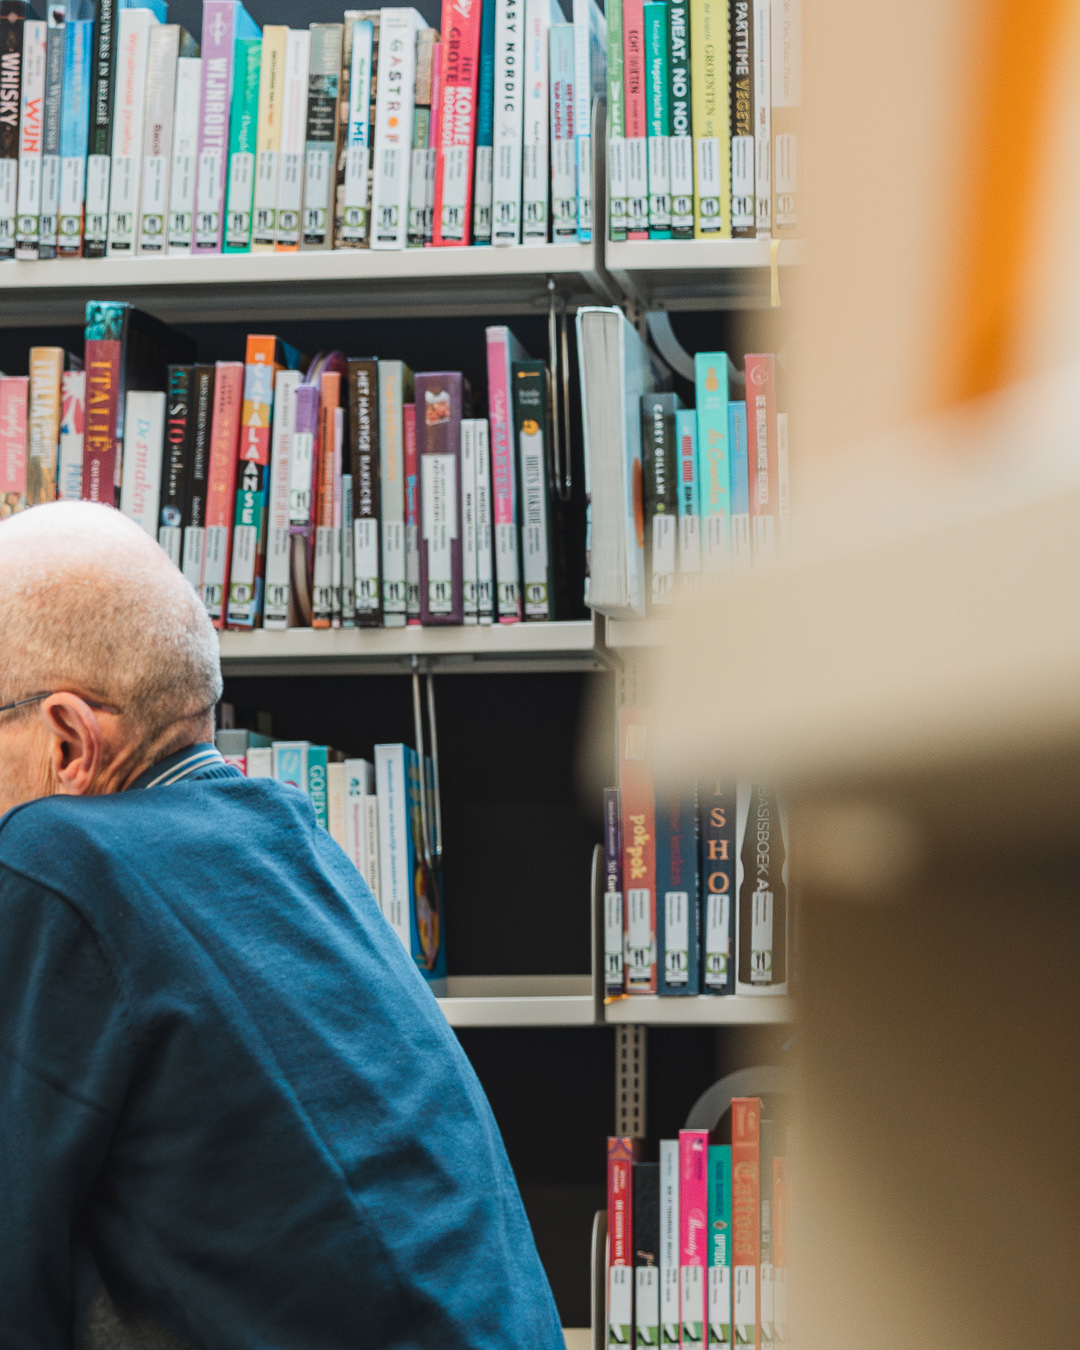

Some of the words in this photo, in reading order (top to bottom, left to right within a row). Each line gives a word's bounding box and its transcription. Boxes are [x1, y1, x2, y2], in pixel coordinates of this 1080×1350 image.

[445, 27, 462, 83] GROTE
[670, 8, 686, 63] MEAT.
[734, 2, 751, 75] PARTTIME
[95, 79, 110, 126] BELGIË
[503, 42, 517, 113] NORDIC
[672, 67, 688, 98] NO
[704, 44, 717, 116] GROENTEN
[22, 98, 42, 153] WIJN
[30, 359, 56, 418] ITALIA
[86, 360, 113, 452] ITALIË
[356, 370, 370, 396] HET
[136, 417, 152, 440] De
[652, 403, 665, 445] CAREY
[131, 440, 152, 514] smaken
[653, 448, 666, 495] GILLAM
[733, 1161, 758, 1256] Tattoos
